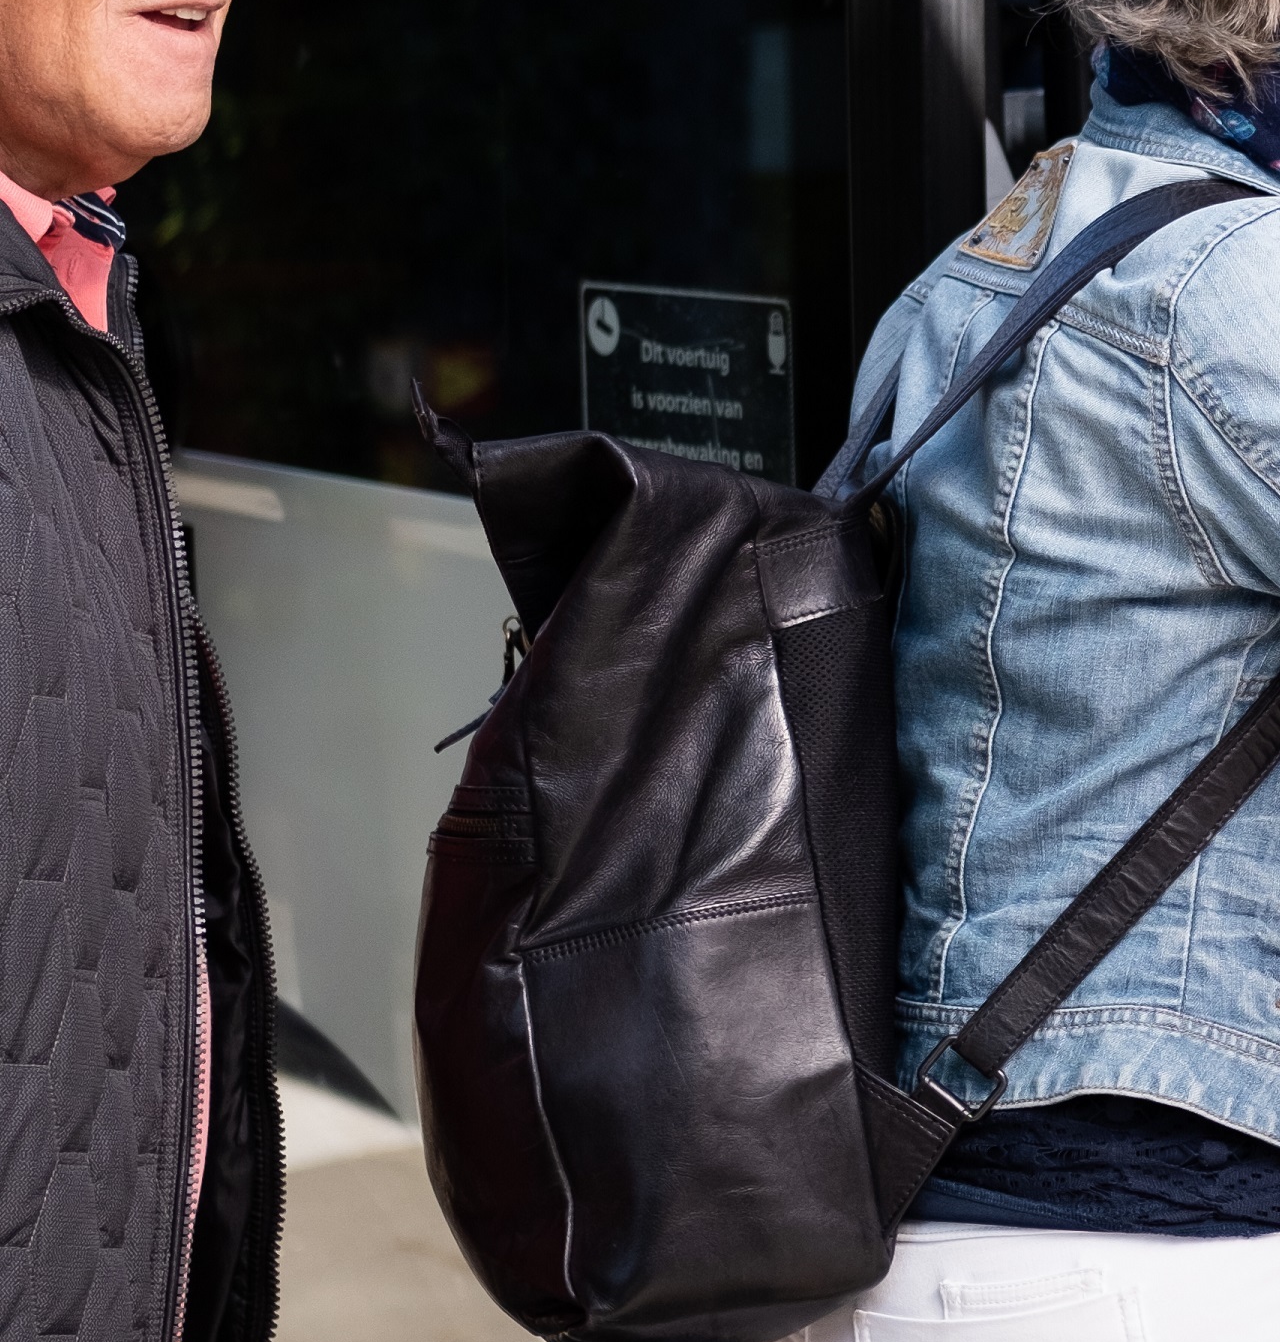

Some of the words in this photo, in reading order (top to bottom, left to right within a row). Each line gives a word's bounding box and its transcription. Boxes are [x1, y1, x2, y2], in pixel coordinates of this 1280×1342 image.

[640, 339, 662, 364] Dit
[667, 346, 730, 377] voertuig
[631, 384, 644, 409] is
[647, 391, 711, 416] voorzien
[715, 399, 743, 421] van
[744, 451, 763, 471] en
